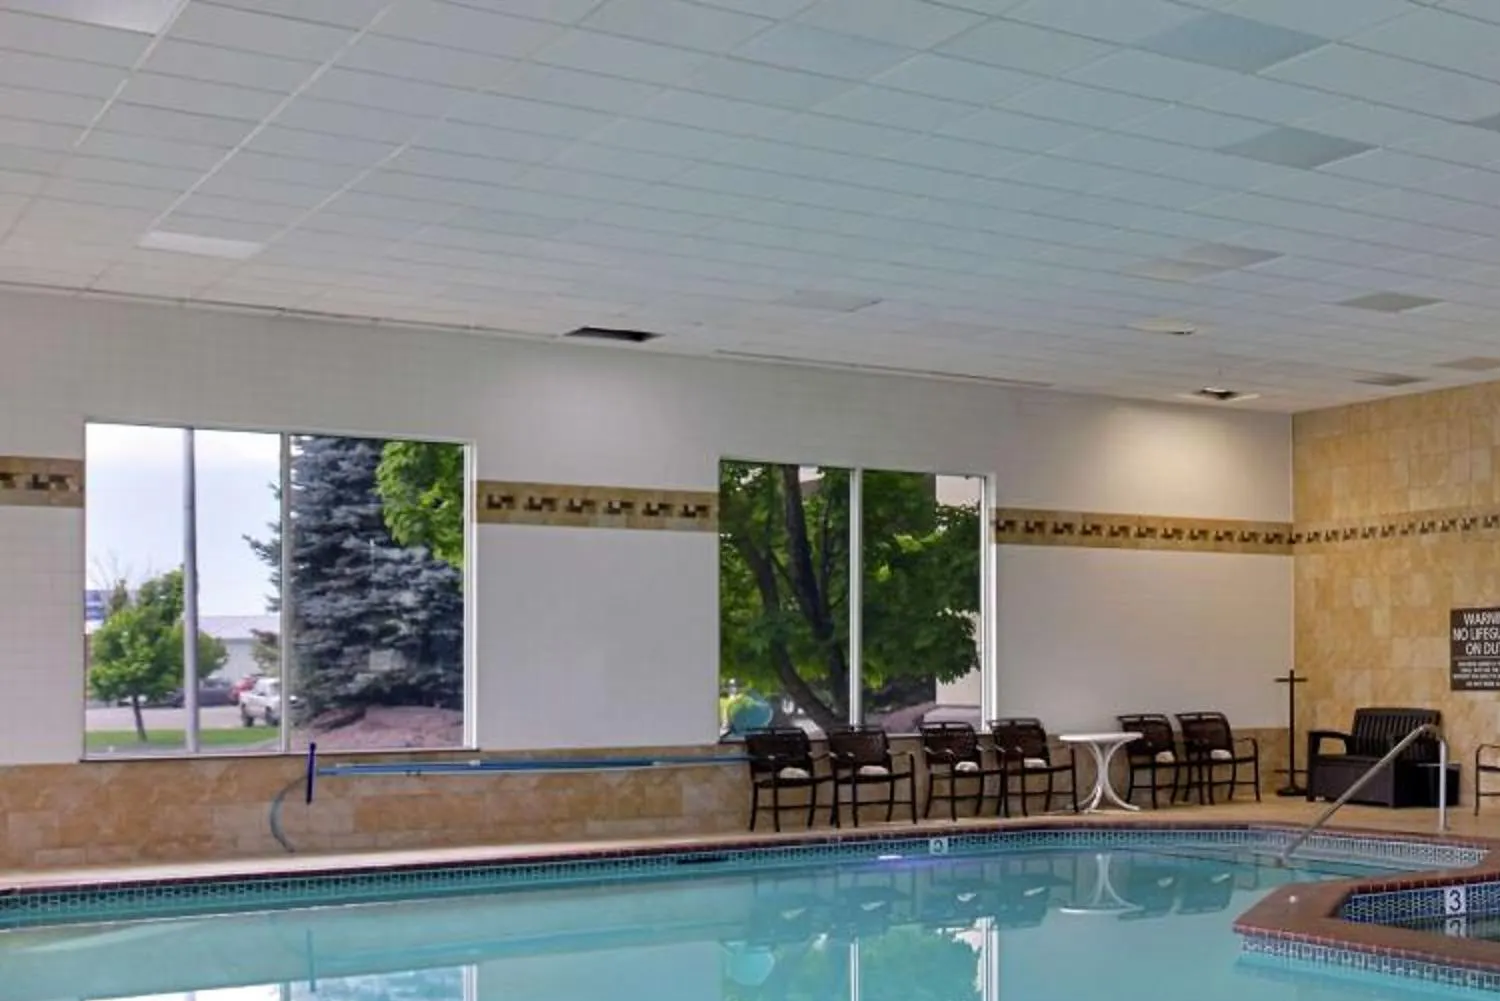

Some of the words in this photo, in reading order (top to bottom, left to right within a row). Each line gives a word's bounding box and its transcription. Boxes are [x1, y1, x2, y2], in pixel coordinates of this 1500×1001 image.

[1453, 627, 1469, 641] NO
[1465, 642, 1481, 655] ON
[1449, 889, 1461, 911] 3
